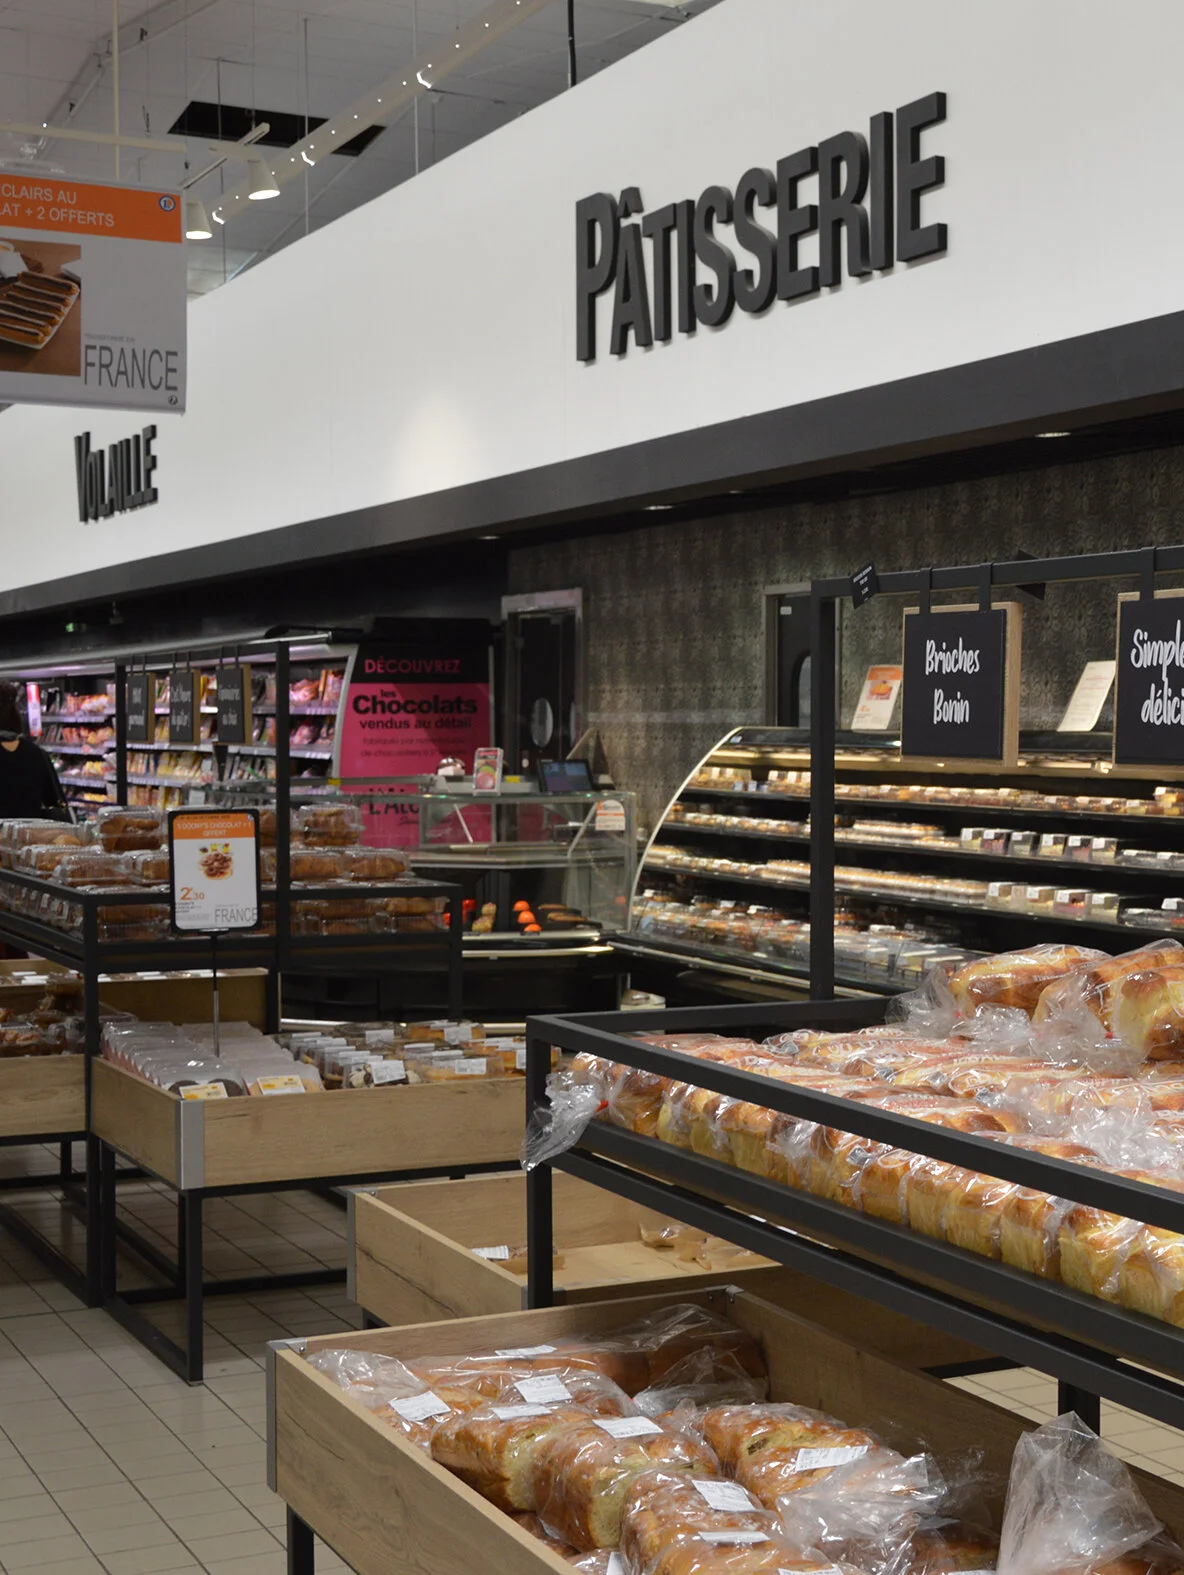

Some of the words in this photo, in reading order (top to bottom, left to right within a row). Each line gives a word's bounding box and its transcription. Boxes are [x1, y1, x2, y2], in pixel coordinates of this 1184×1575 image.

[0, 183, 53, 202] CLAIRS
[57, 190, 77, 205] AU
[25, 208, 33, 216] +
[37, 206, 45, 220] 2
[49, 207, 115, 227] OFFERTS
[576, 91, 948, 362] PÂTISSERIE
[84, 344, 178, 391] FRANCE
[74, 424, 158, 524] VOLAILLE
[364, 656, 461, 674] DÉCOUVREZ
[925, 636, 980, 675] Brioches
[381, 689, 396, 698] les
[352, 695, 478, 715] Chocolats
[933, 688, 970, 725] Bonin
[360, 719, 410, 729] vendus
[414, 720, 431, 729] au
[435, 717, 472, 730] détail
[214, 907, 257, 925] FRANCE
